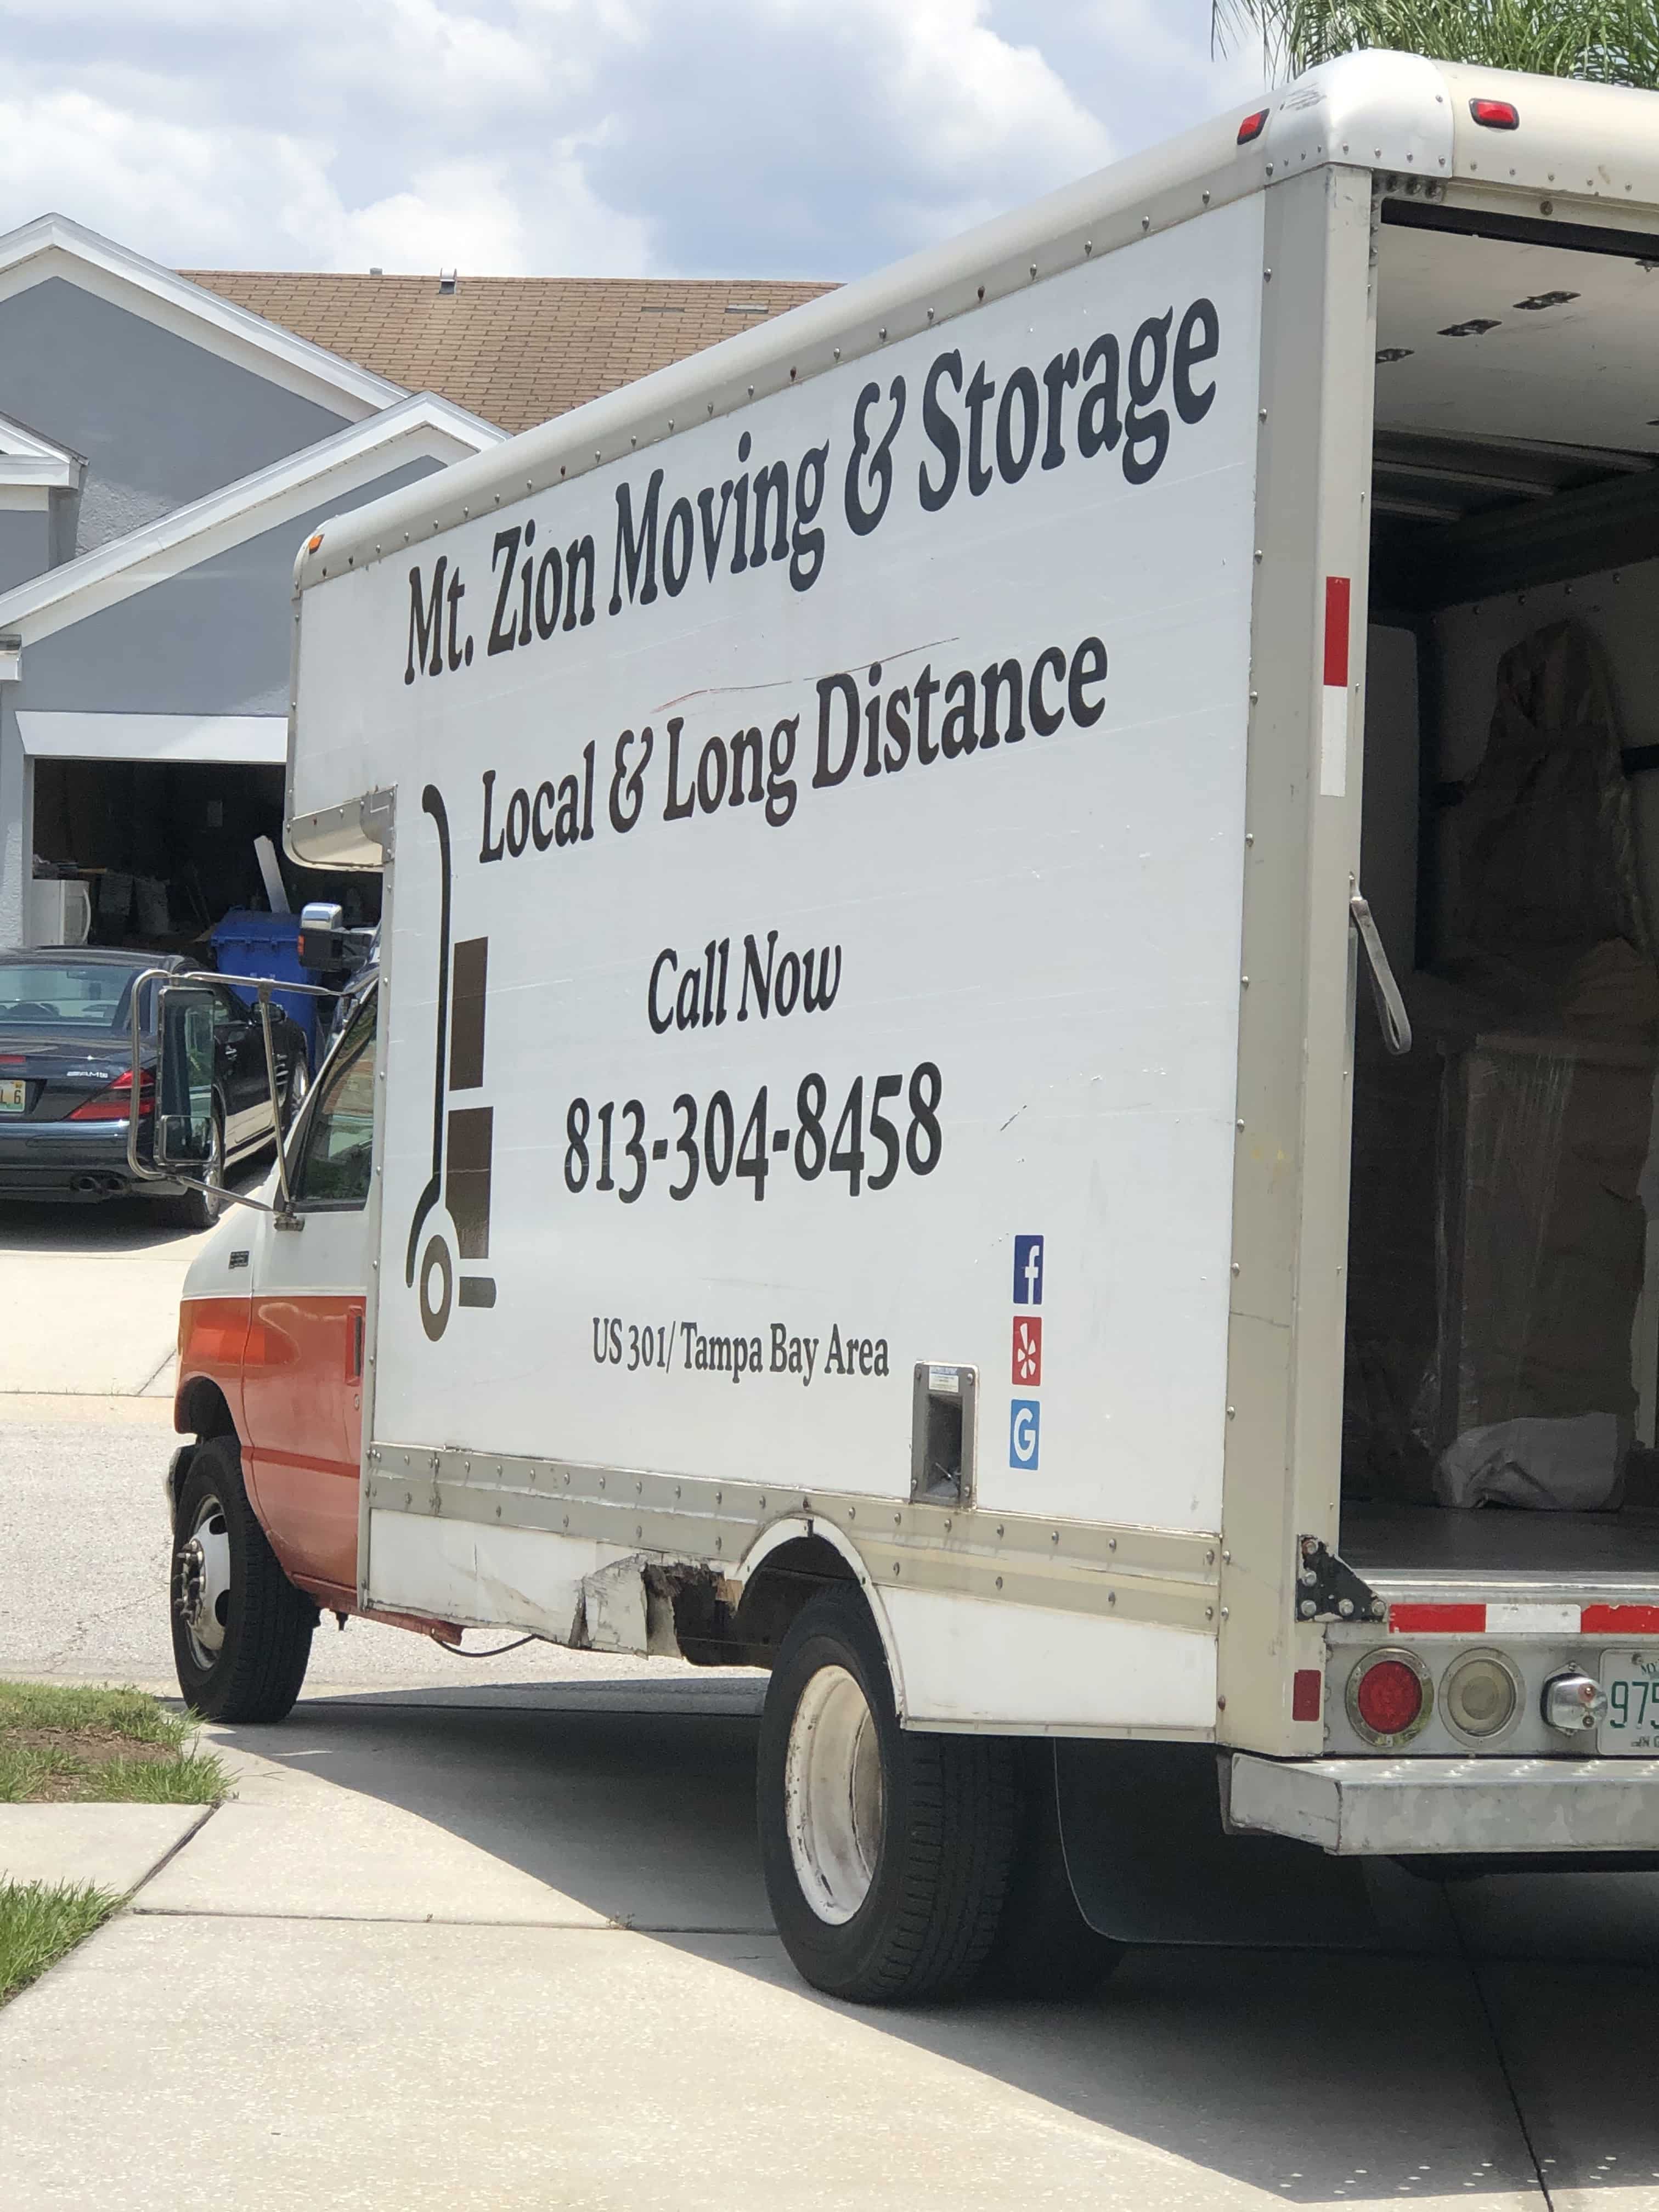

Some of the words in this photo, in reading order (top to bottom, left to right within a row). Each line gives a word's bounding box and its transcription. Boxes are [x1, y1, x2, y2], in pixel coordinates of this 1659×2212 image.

[405, 555, 473, 685] Mt.
[488, 519, 595, 656] Zion
[609, 431, 829, 616] Moving
[844, 375, 906, 536] &
[919, 298, 1219, 511] Storage
[479, 740, 595, 864] Local
[609, 727, 653, 833] &
[663, 713, 800, 827] Long
[812, 637, 1108, 789] Distance
[648, 938, 730, 1034] Call
[737, 930, 842, 1022] Now
[564, 1062, 942, 1204] 813-304-8458
[593, 1317, 622, 1364] US
[680, 1322, 763, 1384] Tampa
[770, 1323, 819, 1386] Bay
[824, 1323, 890, 1376] Area
